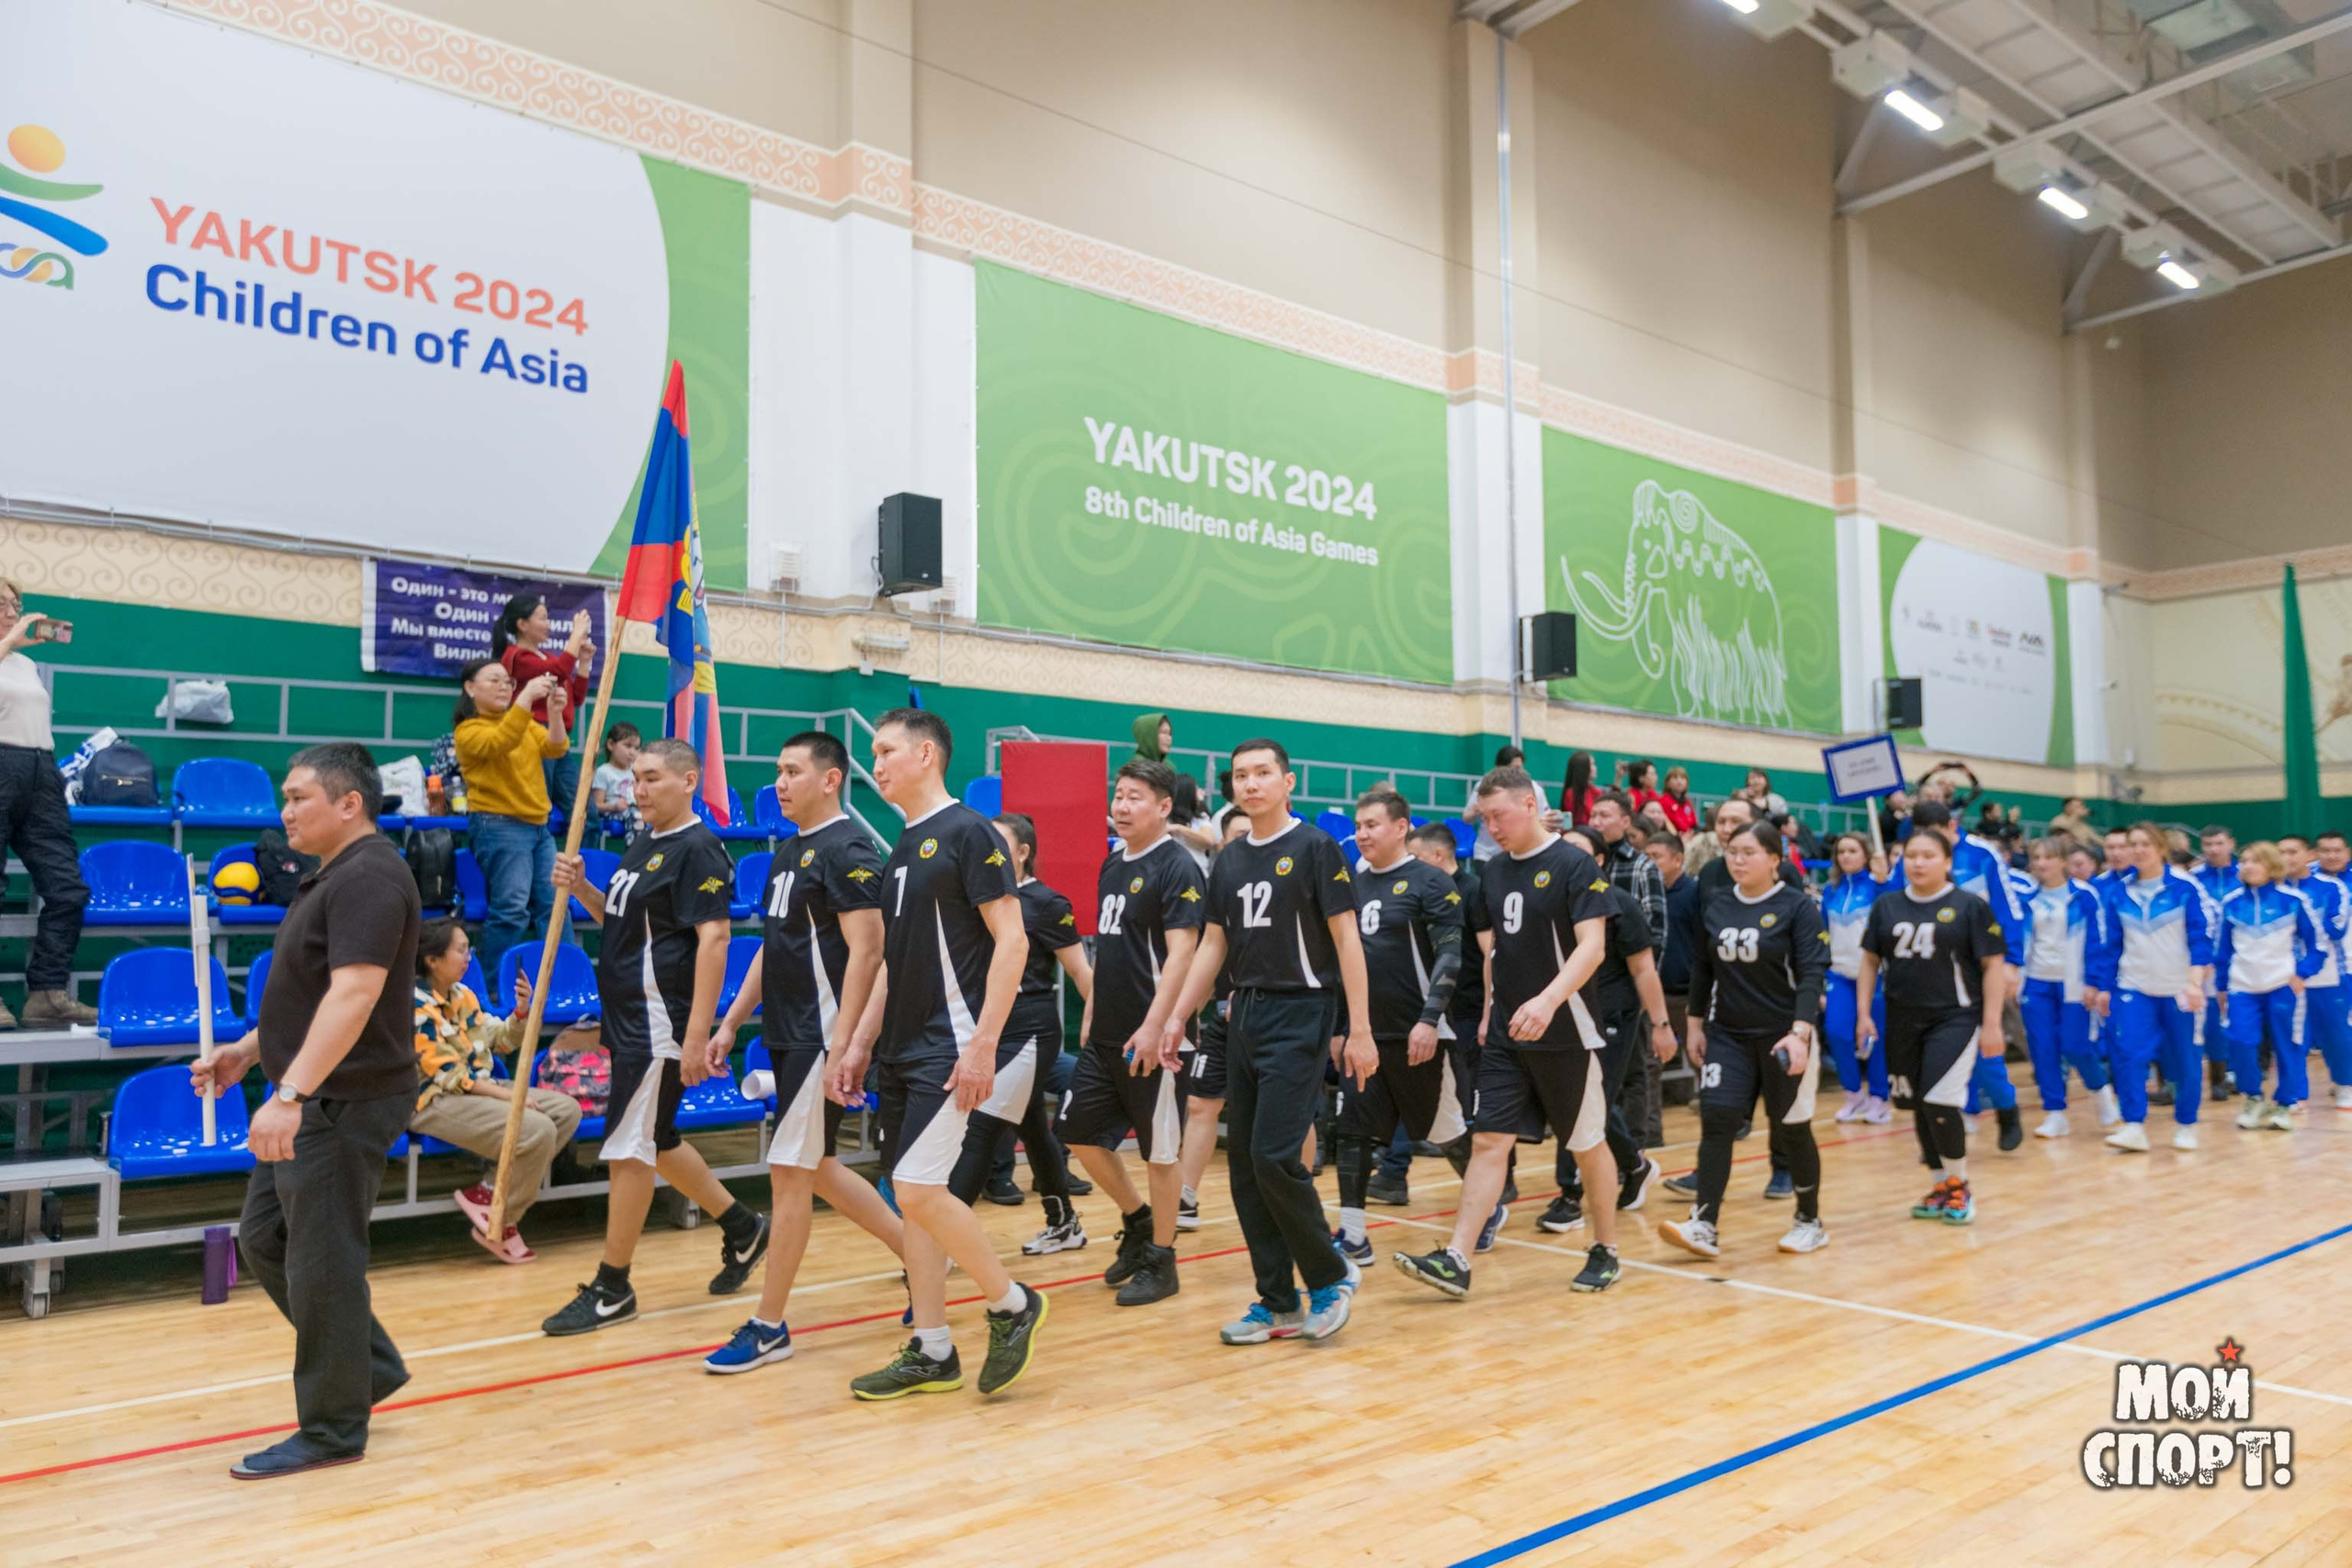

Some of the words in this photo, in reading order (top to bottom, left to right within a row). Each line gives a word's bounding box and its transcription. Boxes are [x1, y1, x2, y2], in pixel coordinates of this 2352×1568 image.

[152, 197, 437, 304] YAKUTSK
[453, 271, 589, 336] 2024
[146, 263, 397, 355] Children
[414, 328, 469, 368] of
[481, 337, 588, 393] Asia
[1083, 416, 1277, 502] YAKUTSK
[1284, 464, 1378, 521] 2024
[1084, 485, 1130, 520] 8th
[1134, 496, 1231, 539] Children
[1234, 517, 1259, 544] of
[1261, 522, 1307, 554] Asia
[1310, 531, 1379, 567] Games
[391, 576, 445, 598] Один
[460, 588, 489, 604] это
[435, 602, 490, 624] Один
[391, 617, 424, 637] Мы
[427, 625, 492, 643] вместе
[605, 868, 640, 918] 21
[767, 870, 796, 919] 10
[894, 865, 909, 918] 7
[1098, 893, 1126, 935] 82
[1237, 880, 1272, 929] 12
[1503, 891, 1524, 935] 9
[1360, 898, 1383, 936] 6
[1892, 921, 1936, 959] 24
[1716, 927, 1760, 963] 33
